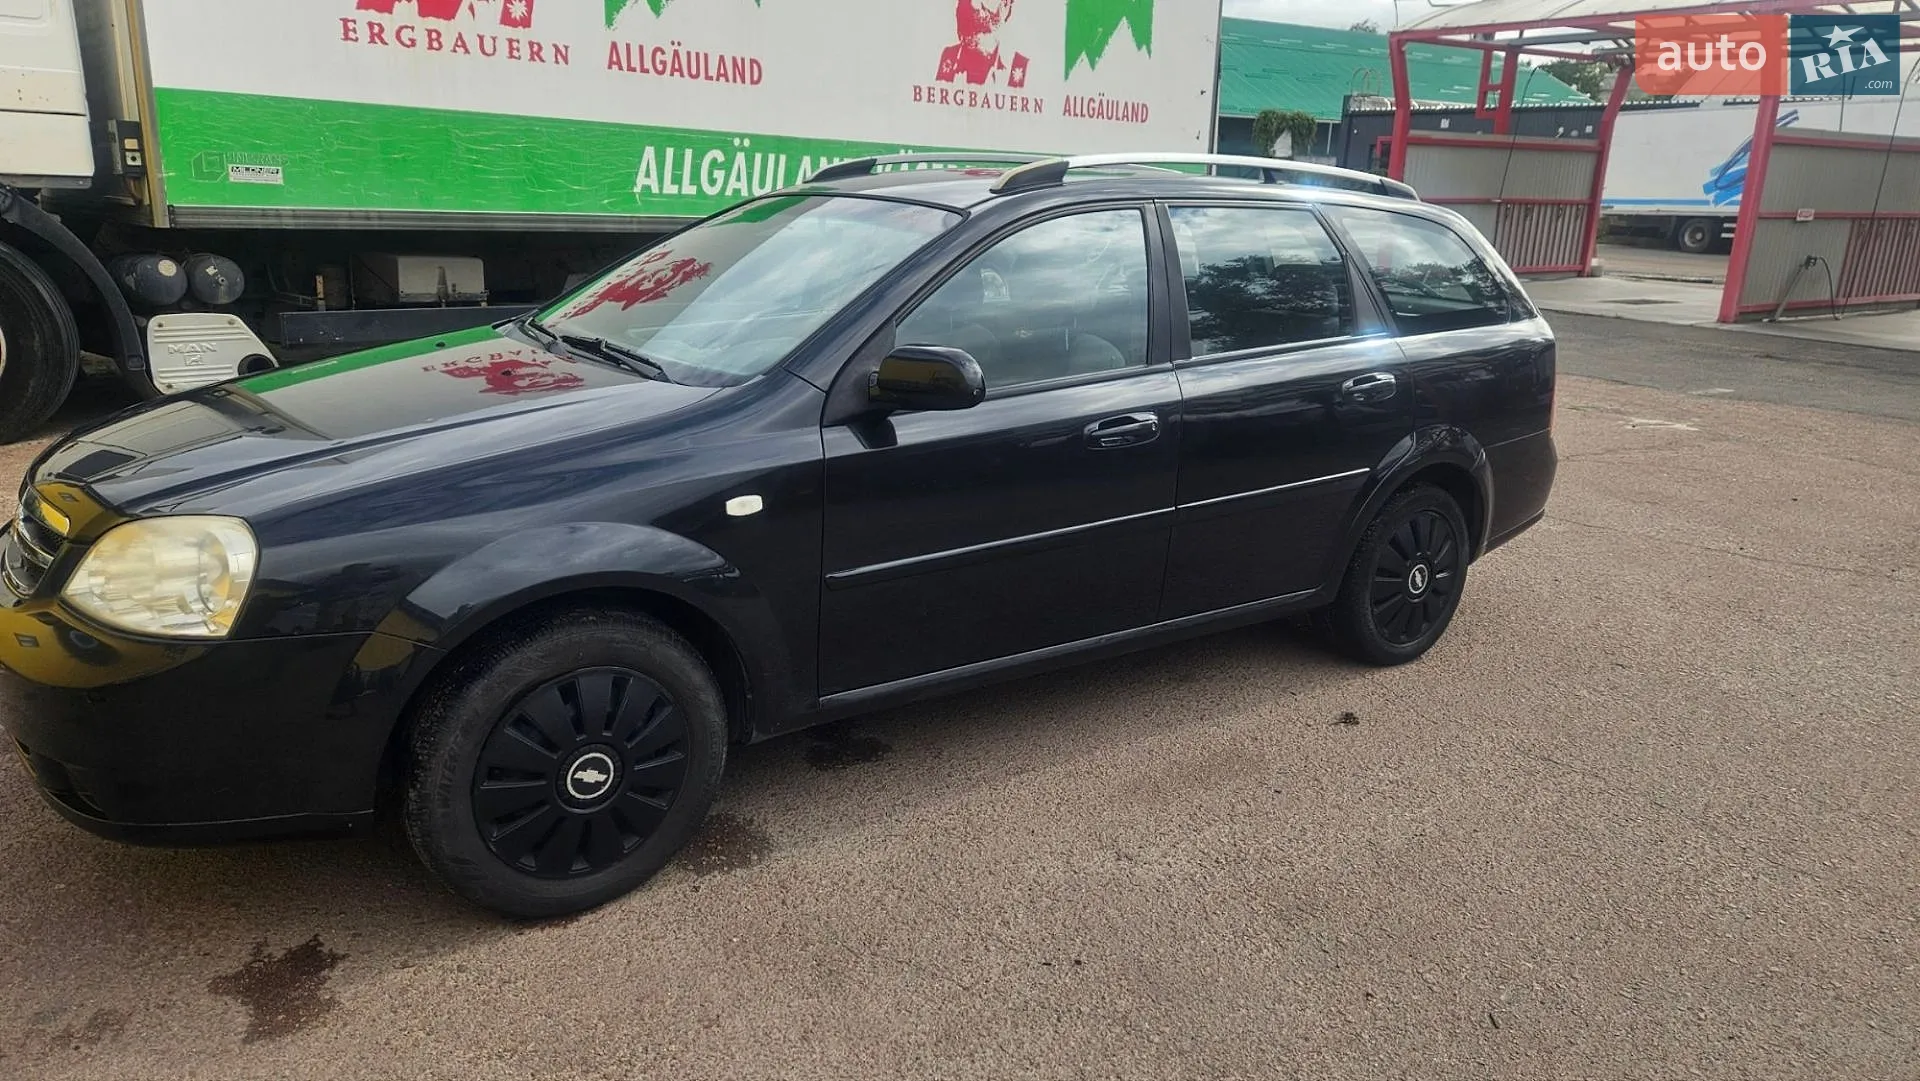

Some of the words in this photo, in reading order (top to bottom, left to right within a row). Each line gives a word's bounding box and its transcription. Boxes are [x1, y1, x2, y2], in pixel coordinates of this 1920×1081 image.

[339, 17, 571, 66] ERGBAUERN
[607, 40, 763, 86] ALLGÄULAND
[913, 85, 1044, 114] BERGBAUERN
[1062, 92, 1149, 124] ALLGÄULAND
[168, 342, 217, 354] MAN
